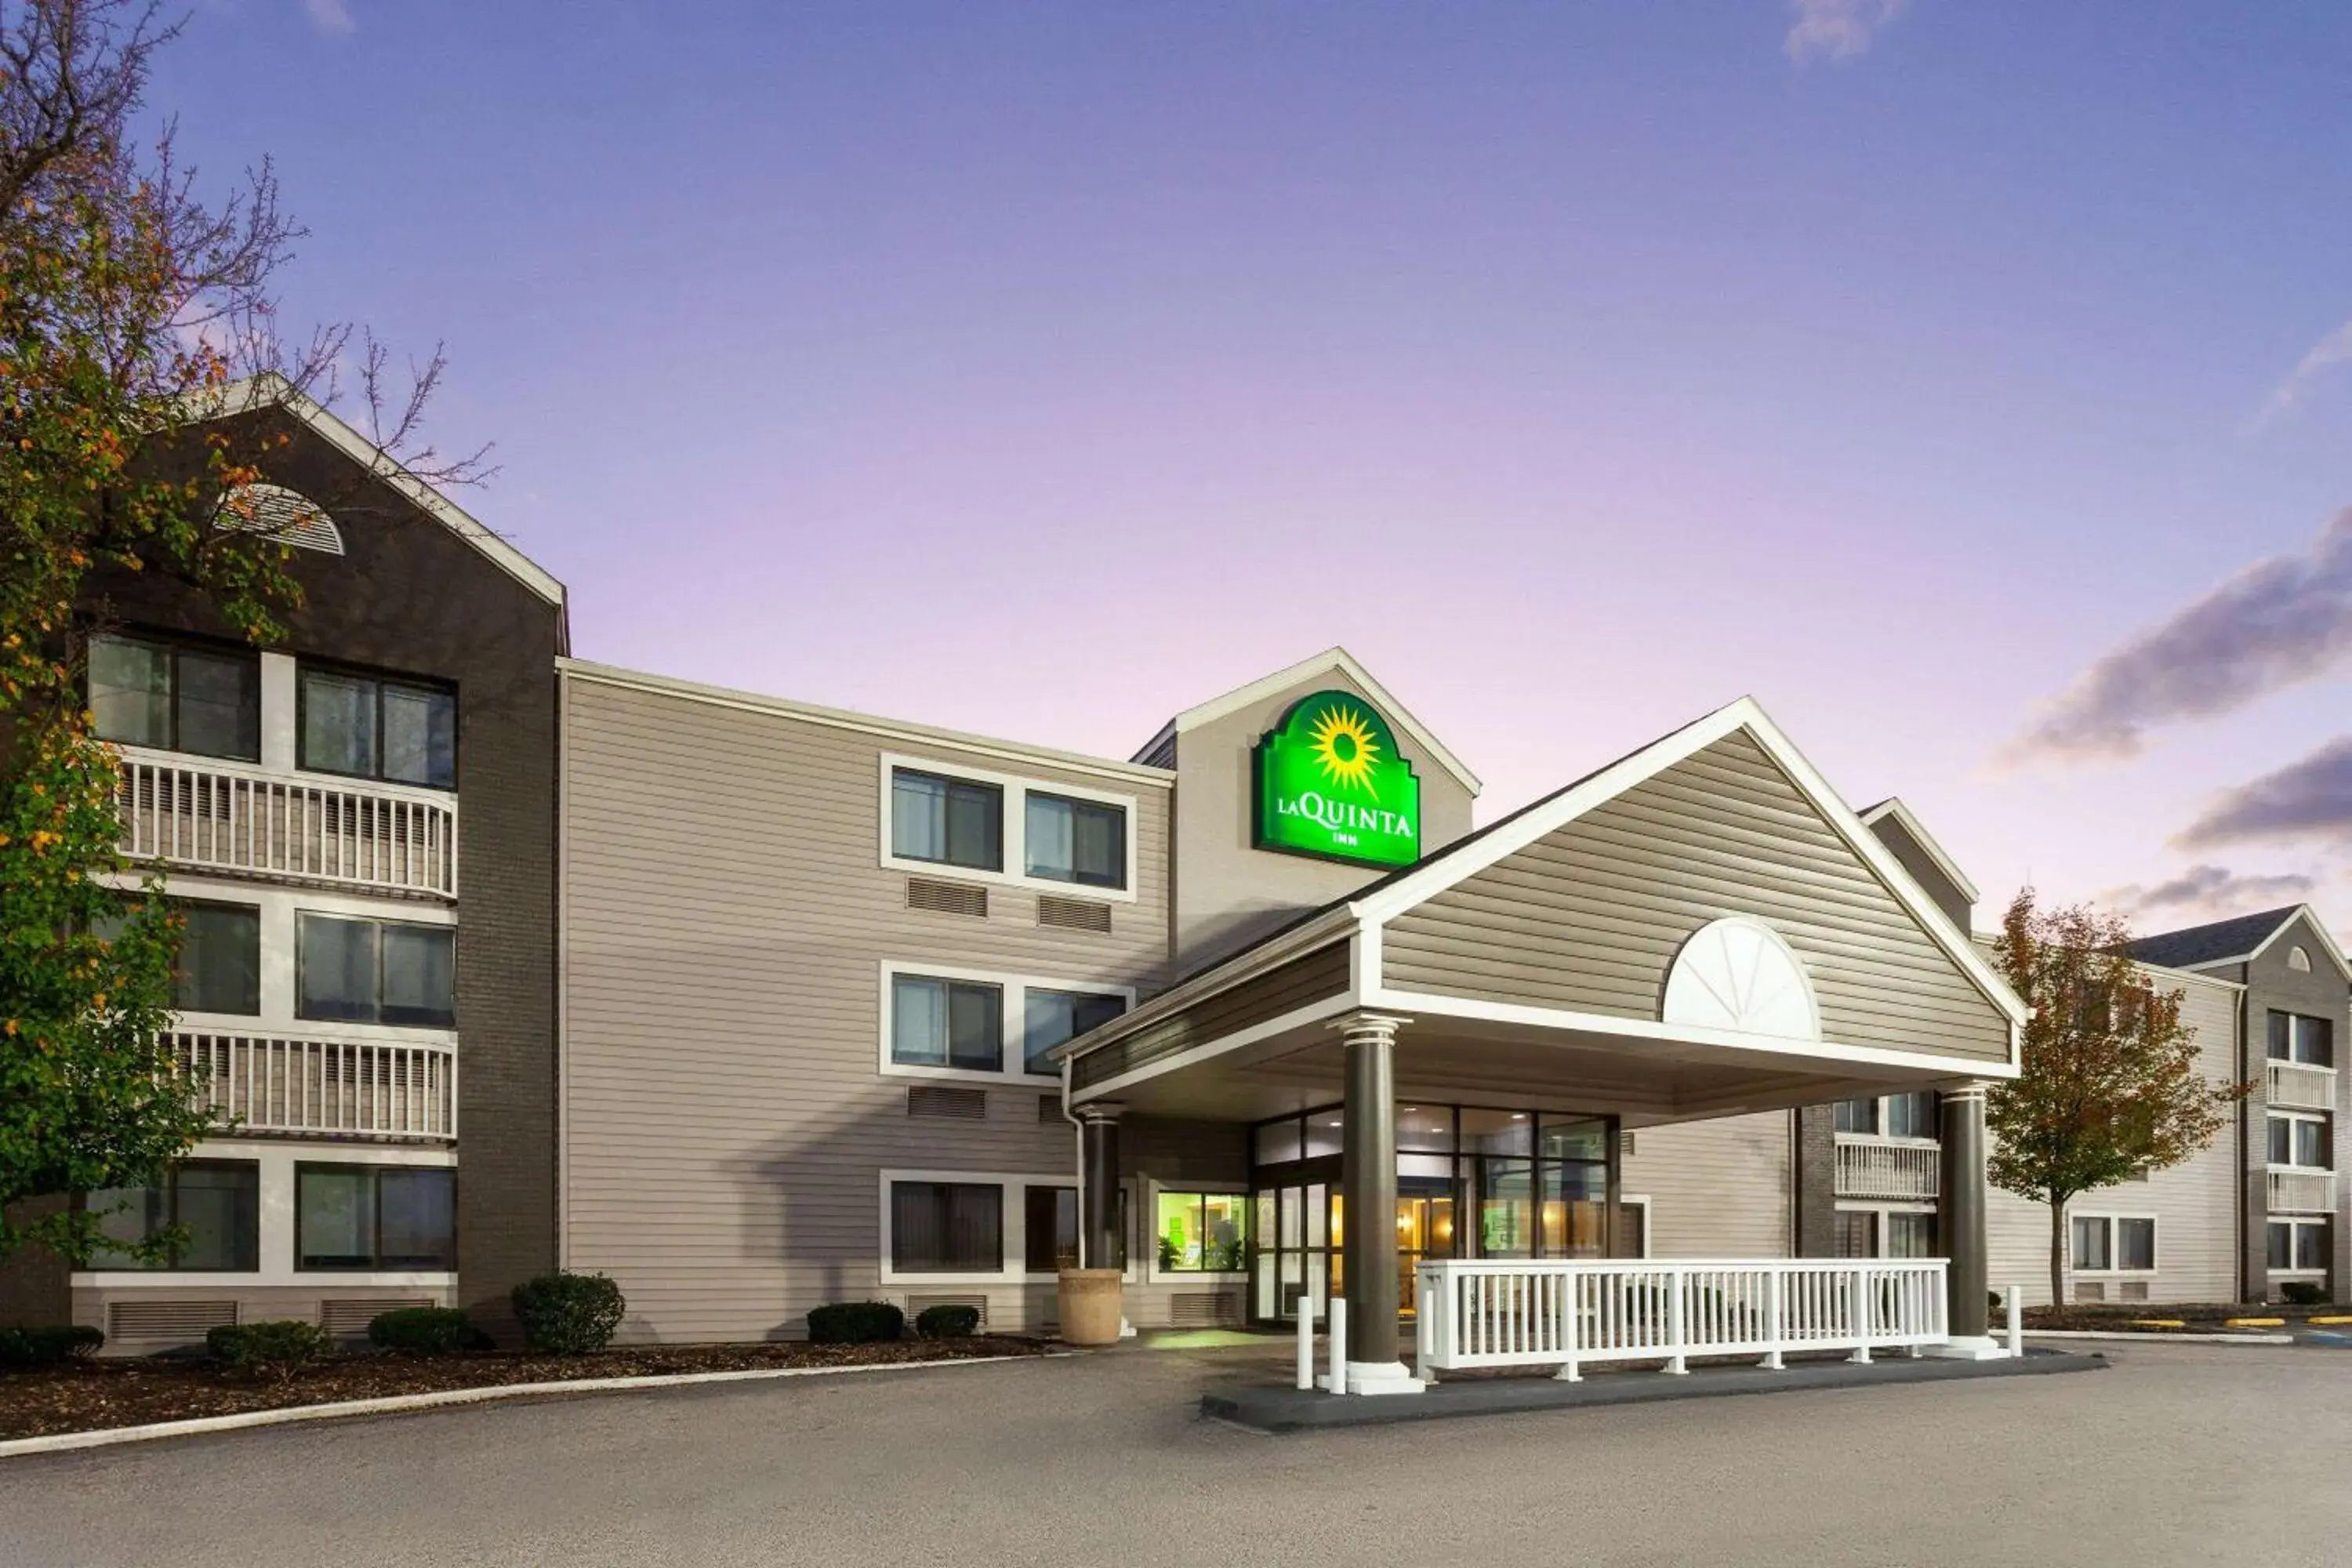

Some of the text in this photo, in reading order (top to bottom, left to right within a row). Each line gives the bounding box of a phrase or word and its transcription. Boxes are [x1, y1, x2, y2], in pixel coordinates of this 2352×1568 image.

[1278, 791, 1412, 837] LA QUINTA
[1333, 831, 1358, 847] INN
